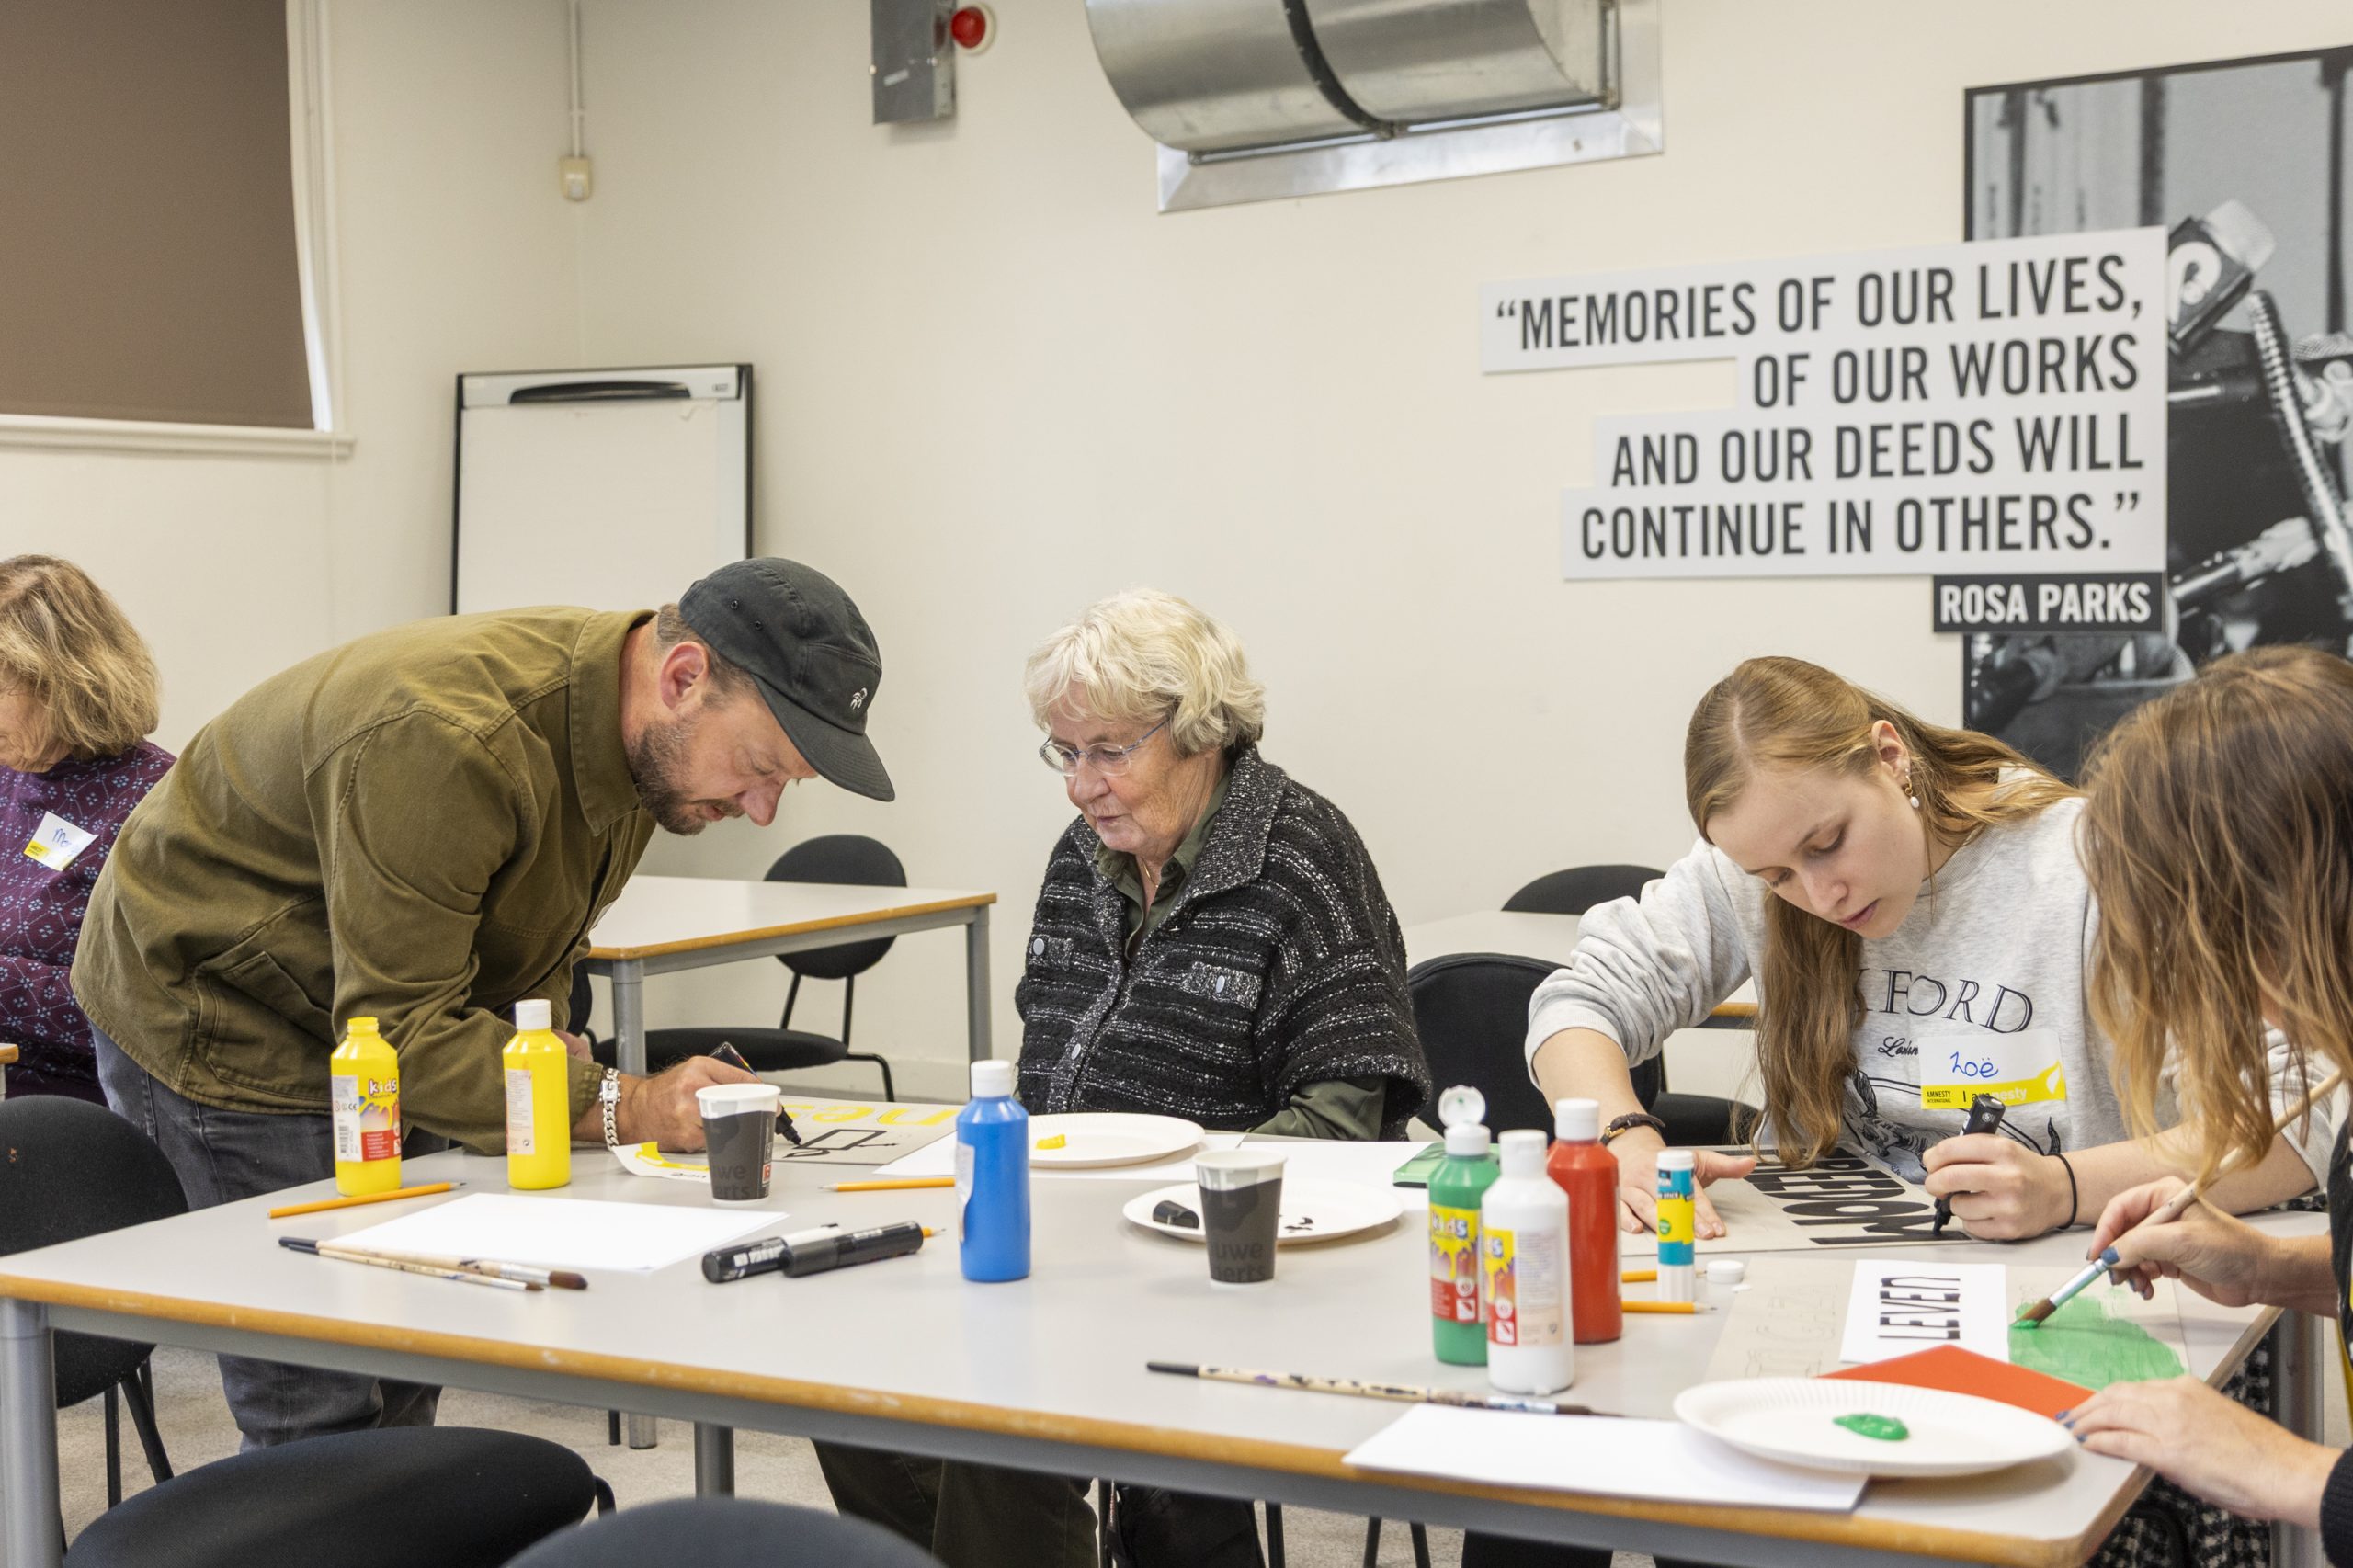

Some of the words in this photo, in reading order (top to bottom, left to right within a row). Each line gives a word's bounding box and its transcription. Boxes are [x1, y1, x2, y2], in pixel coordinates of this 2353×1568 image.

[1497, 281, 1756, 351] “MEMORIES
[1778, 276, 1836, 334] OF
[1857, 267, 1955, 327] OUR
[1979, 254, 2143, 321] LIVES,
[1753, 353, 1810, 408] OF
[1831, 347, 1928, 404] OUR
[1950, 333, 2139, 398] WORKS
[1611, 432, 1699, 487] AND
[1721, 427, 1813, 483] OUR
[1836, 419, 1994, 479] DEEDS
[2015, 412, 2143, 472] WILL
[1581, 500, 1806, 560] CONTINUE
[1828, 499, 1873, 555] IN
[1895, 491, 2142, 553] OTHERS.”
[1939, 583, 2028, 624] ROSA
[2038, 581, 2152, 623] PARKS
[369, 1077, 398, 1096] kids
[1926, 1090, 1951, 1098] AMNESTY
